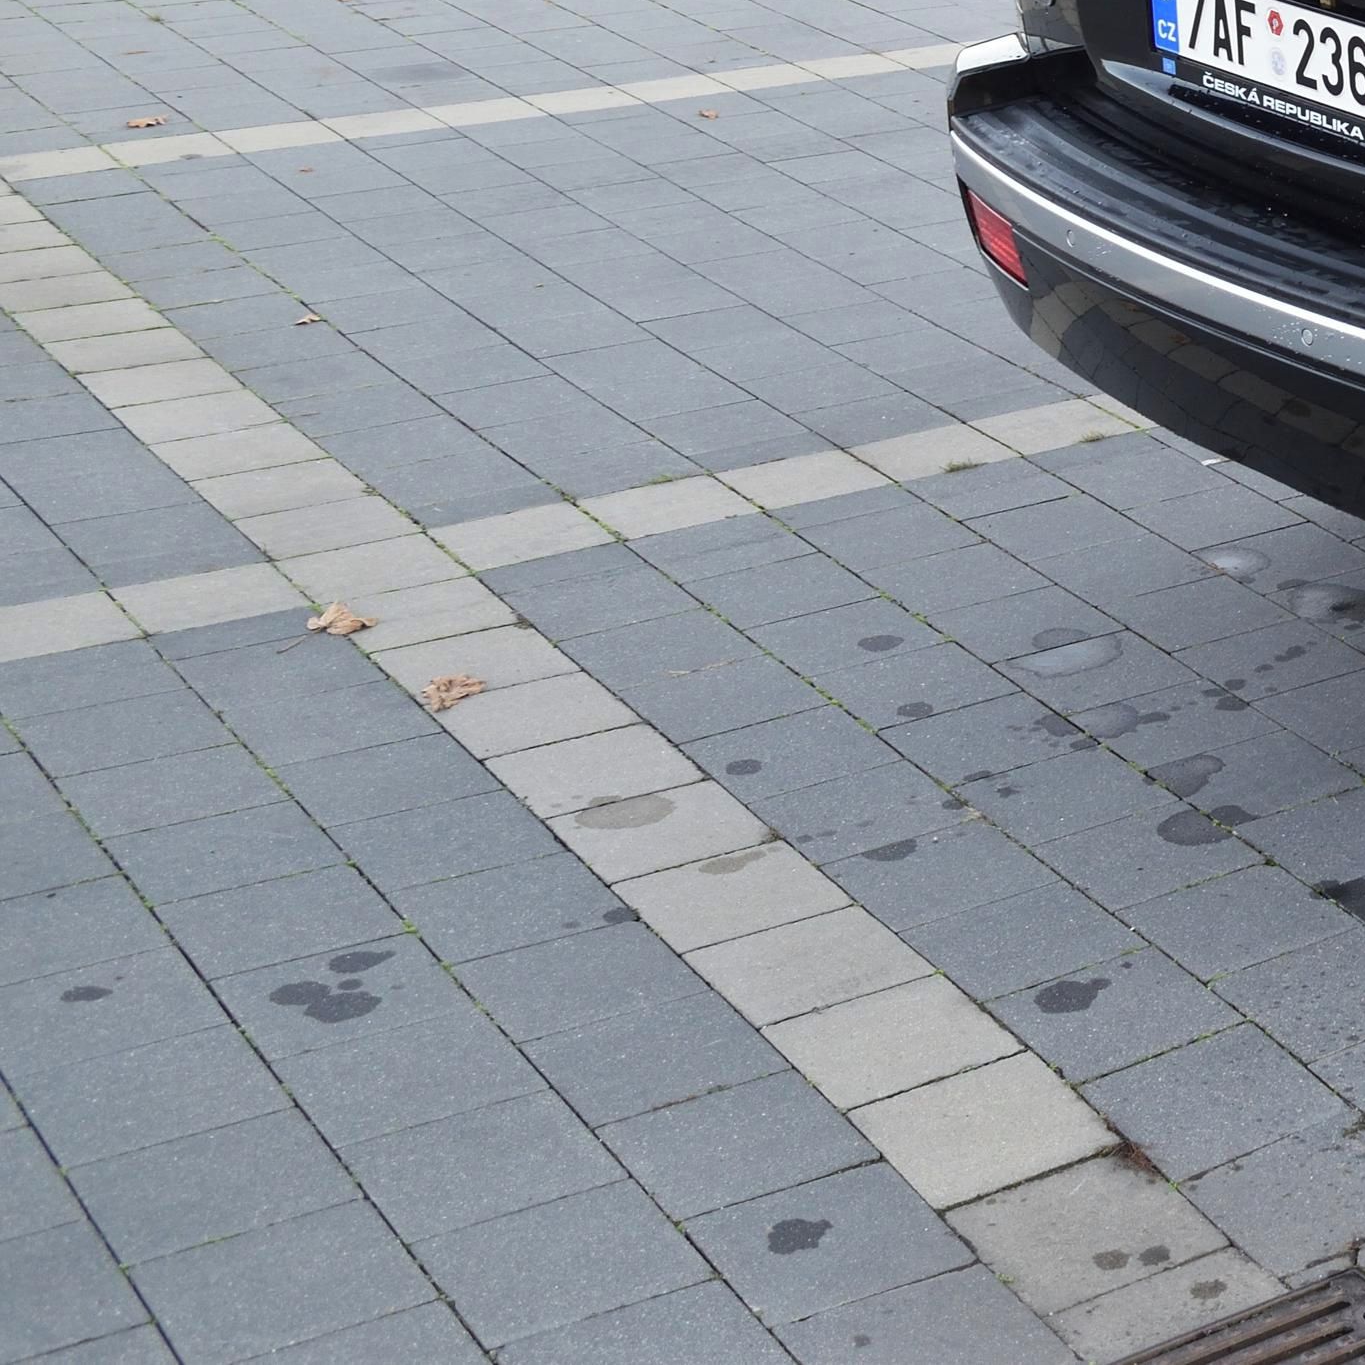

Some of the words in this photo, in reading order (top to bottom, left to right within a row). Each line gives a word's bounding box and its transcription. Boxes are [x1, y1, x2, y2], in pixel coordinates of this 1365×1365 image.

[1157, 18, 1177, 43] CZ
[1202, 71, 1260, 106] ČESKÁ
[1262, 95, 1365, 141] REPUBLIKA
